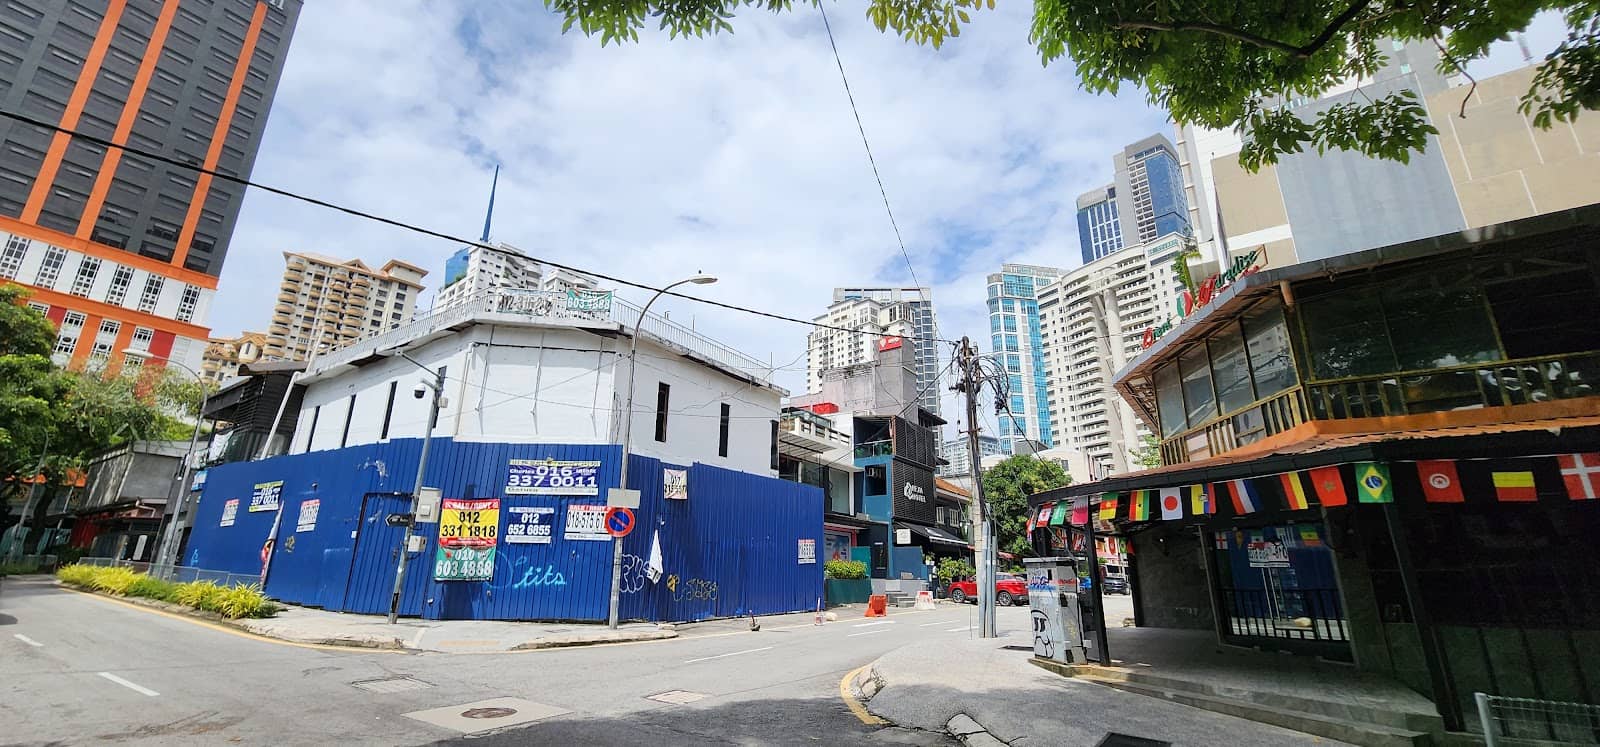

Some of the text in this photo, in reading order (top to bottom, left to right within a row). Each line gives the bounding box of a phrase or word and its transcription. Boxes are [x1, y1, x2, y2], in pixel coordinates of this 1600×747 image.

[536, 465, 573, 477] 016
[508, 475, 598, 487] 337 0011
[459, 511, 480, 524] 012
[521, 513, 540, 524] 012
[567, 511, 594, 529] 018-575
[441, 524, 496, 538] 331 1818
[507, 524, 551, 536] 652 6855
[435, 560, 459, 577] 603
